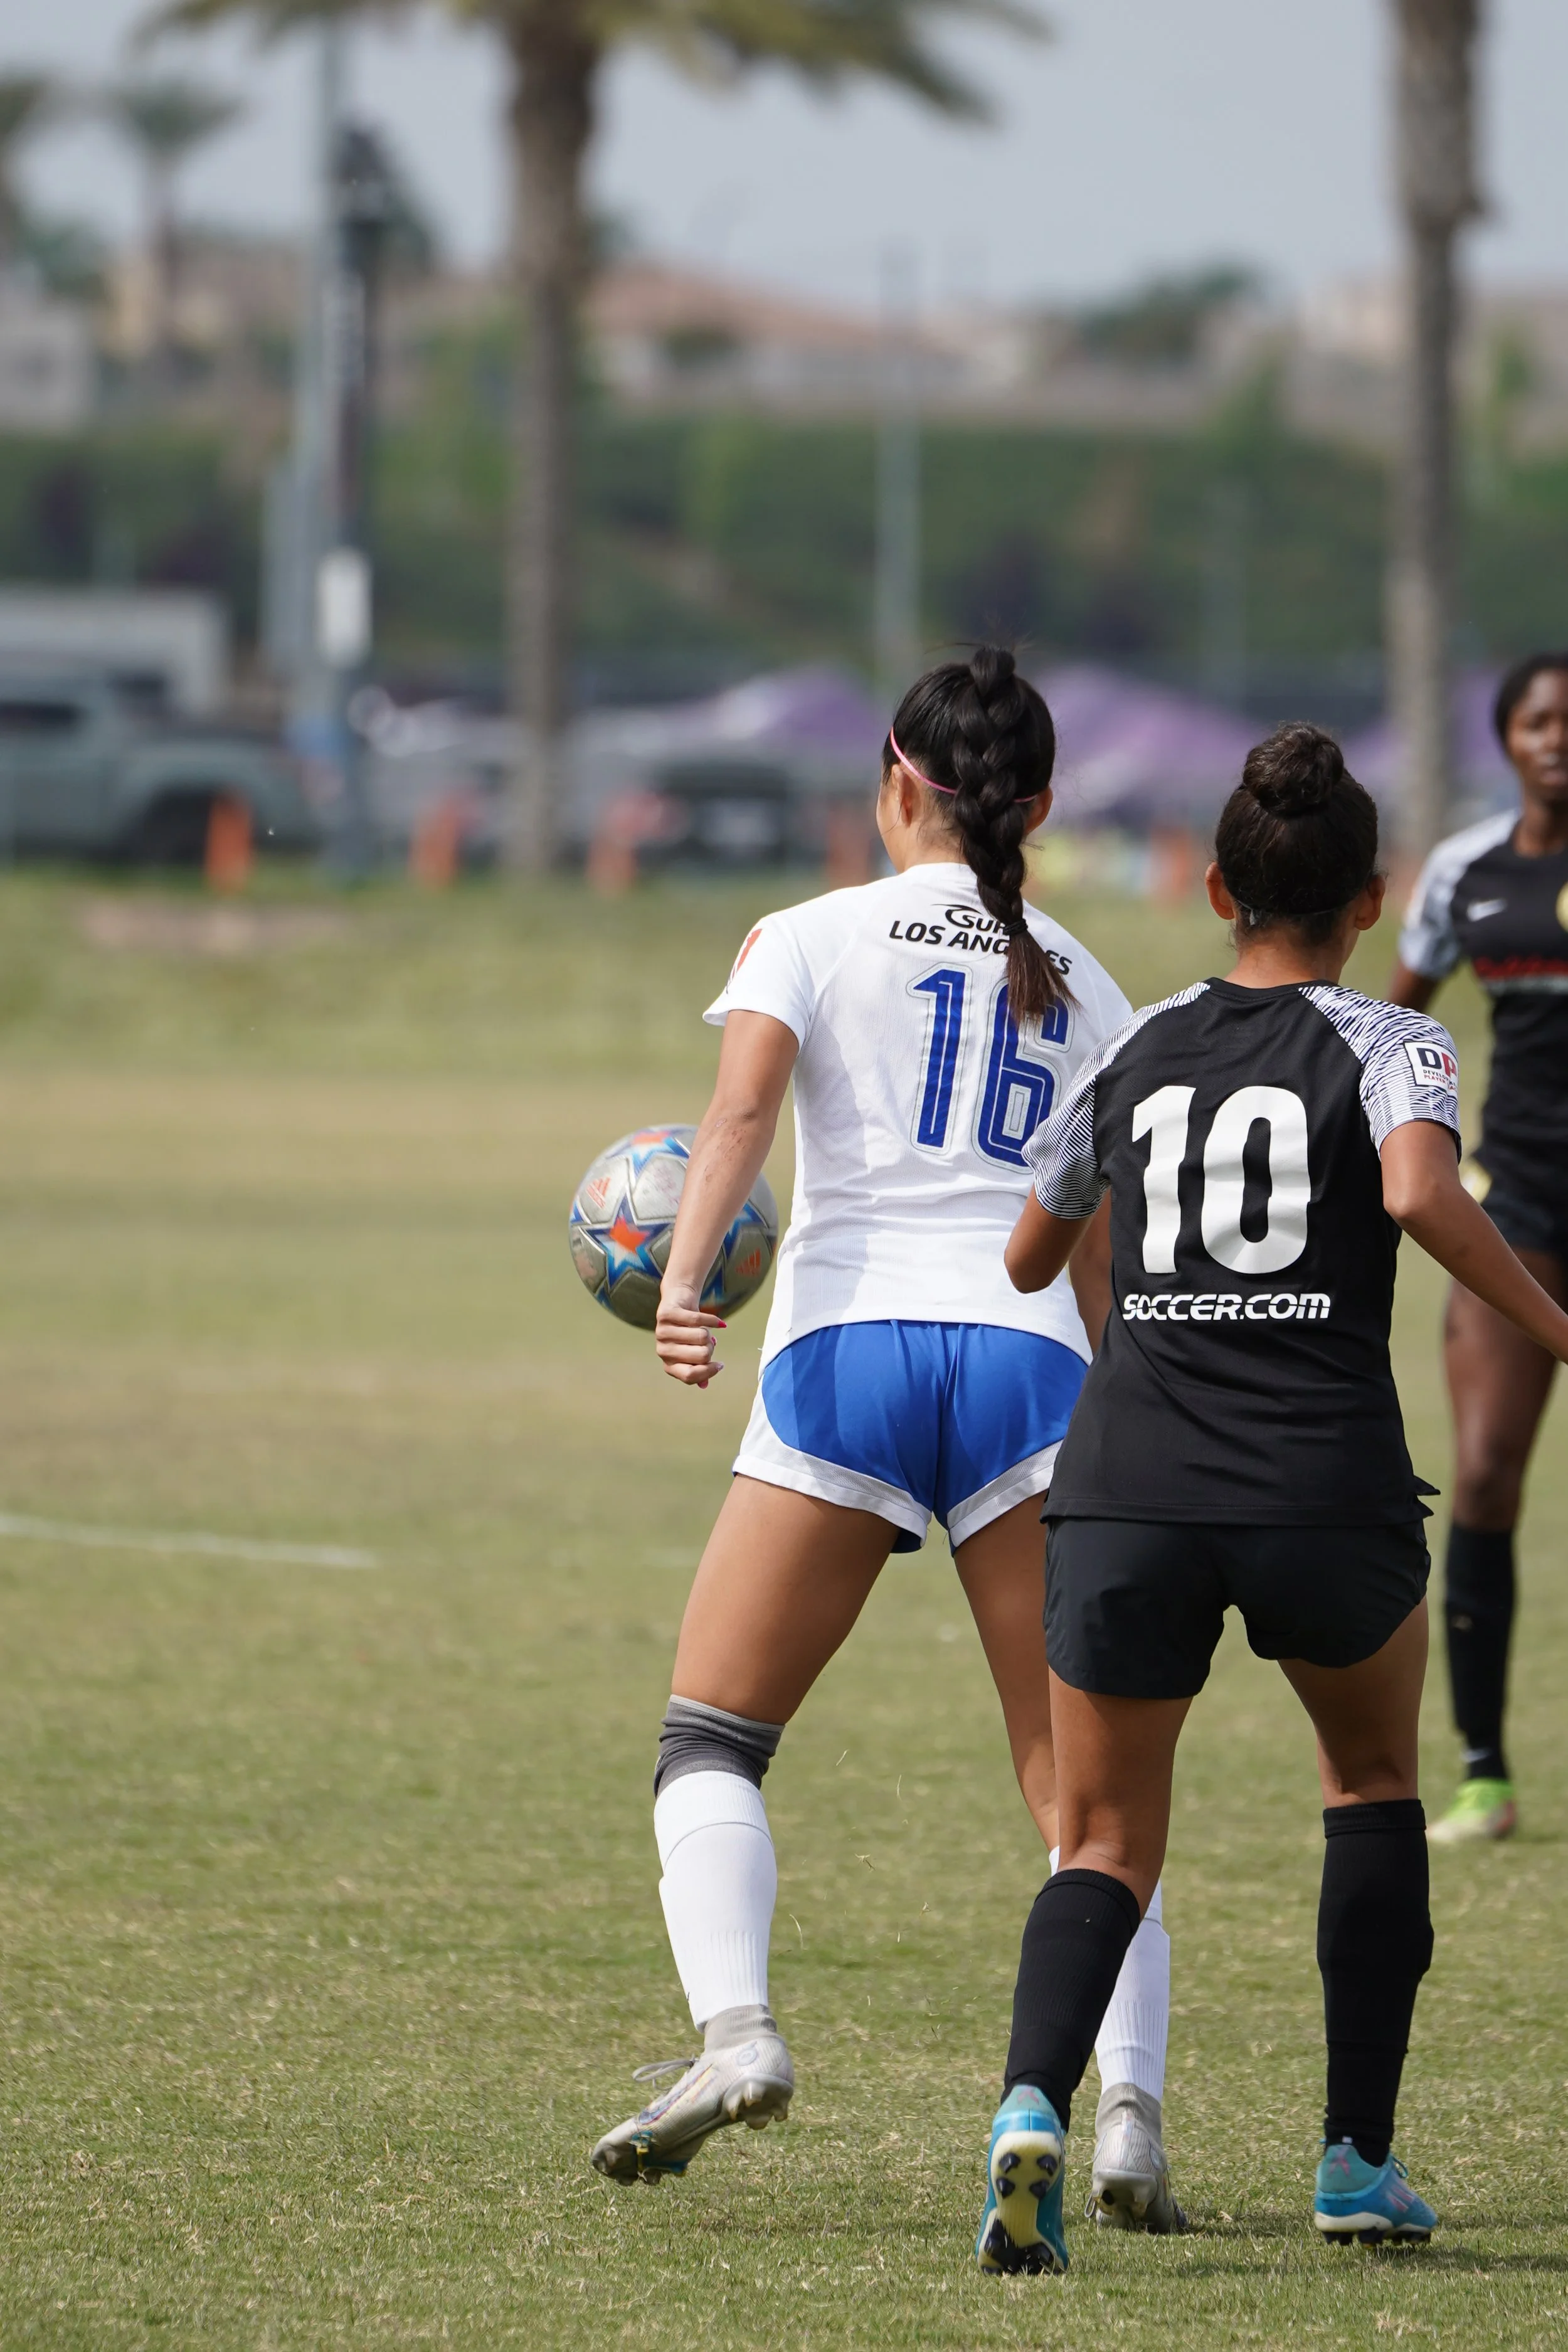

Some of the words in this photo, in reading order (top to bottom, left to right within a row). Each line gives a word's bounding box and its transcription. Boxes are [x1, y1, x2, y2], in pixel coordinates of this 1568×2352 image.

[889, 920, 946, 945] LOS
[947, 931, 1073, 975] ANGES
[906, 963, 1074, 1174] 16
[1131, 1085, 1311, 1274] 10
[1122, 1293, 1332, 1321] SOCCER.COM
